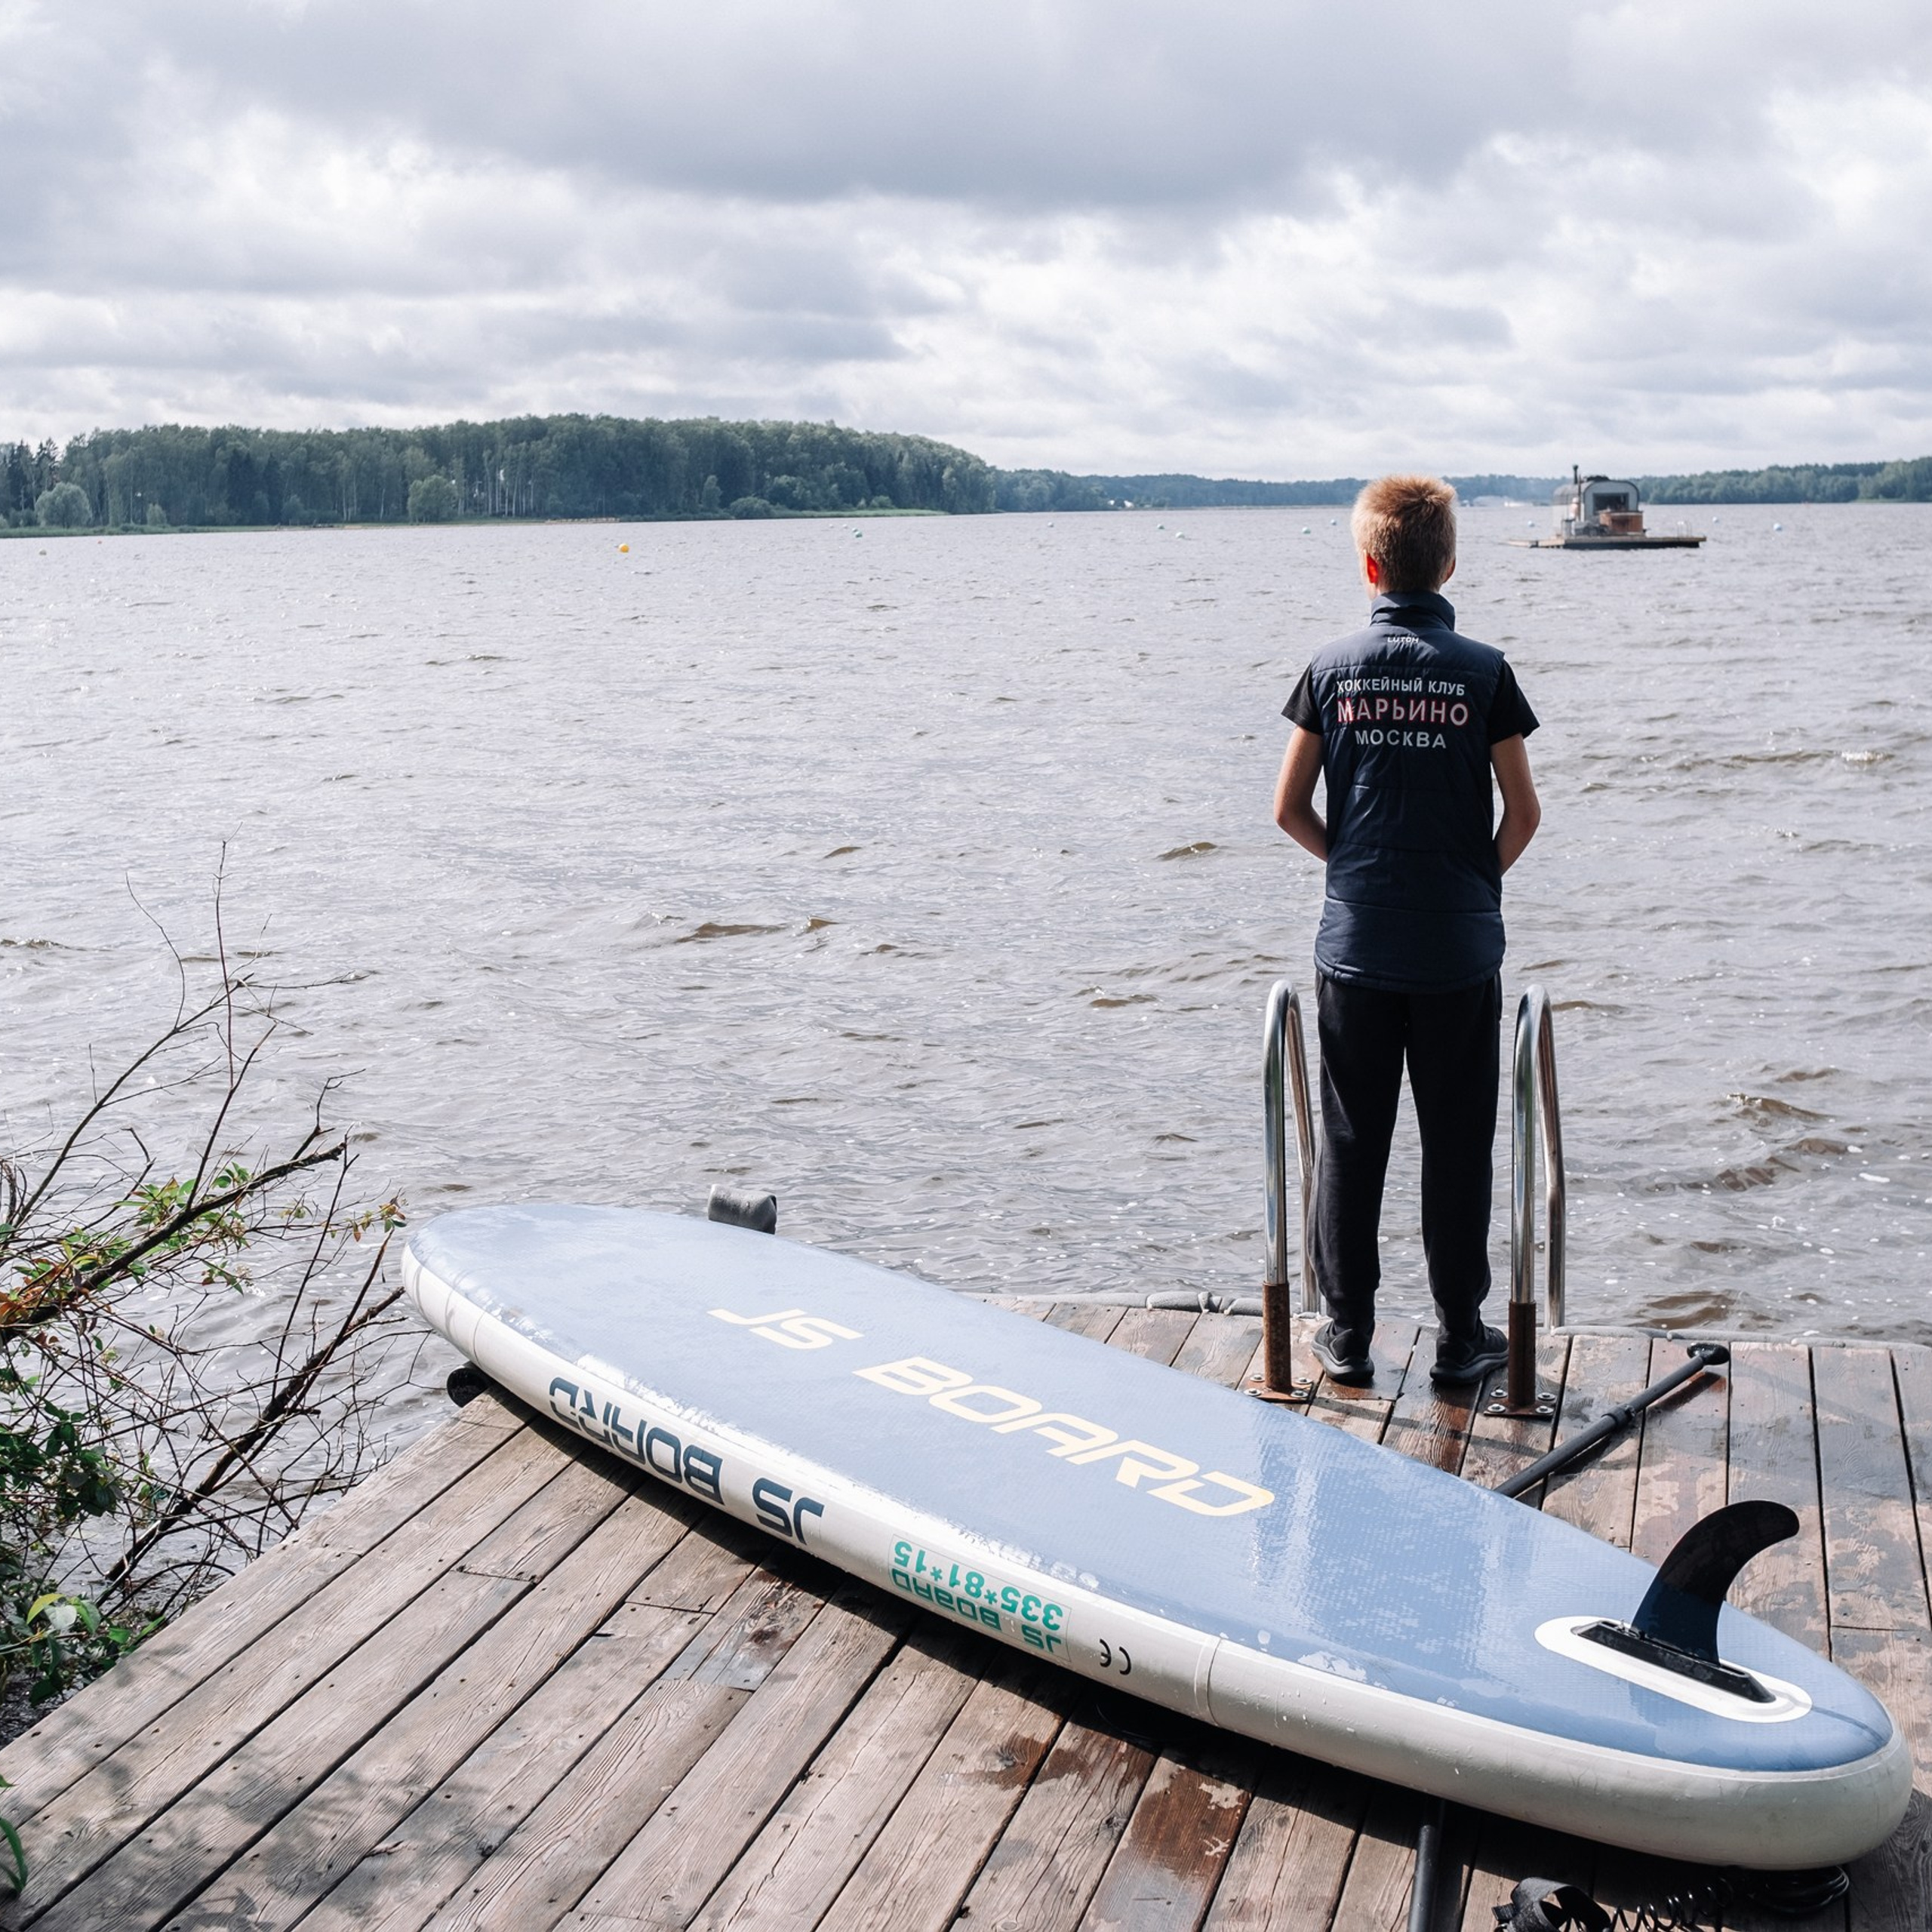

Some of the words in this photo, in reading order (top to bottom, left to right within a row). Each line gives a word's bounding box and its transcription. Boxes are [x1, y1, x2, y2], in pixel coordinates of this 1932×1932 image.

[1337, 676, 1423, 693] ХОККЕЙНЫЙ
[1429, 681, 1466, 696] КЛУБ
[1337, 697, 1469, 726] МАРЬИНО
[1355, 728, 1447, 749] МОСКВА
[707, 1309, 864, 1349] JS
[852, 1356, 1275, 1516] BOARD
[549, 1377, 724, 1506] BOARD
[752, 1477, 825, 1546] JS
[1021, 1624, 1061, 1654] JS
